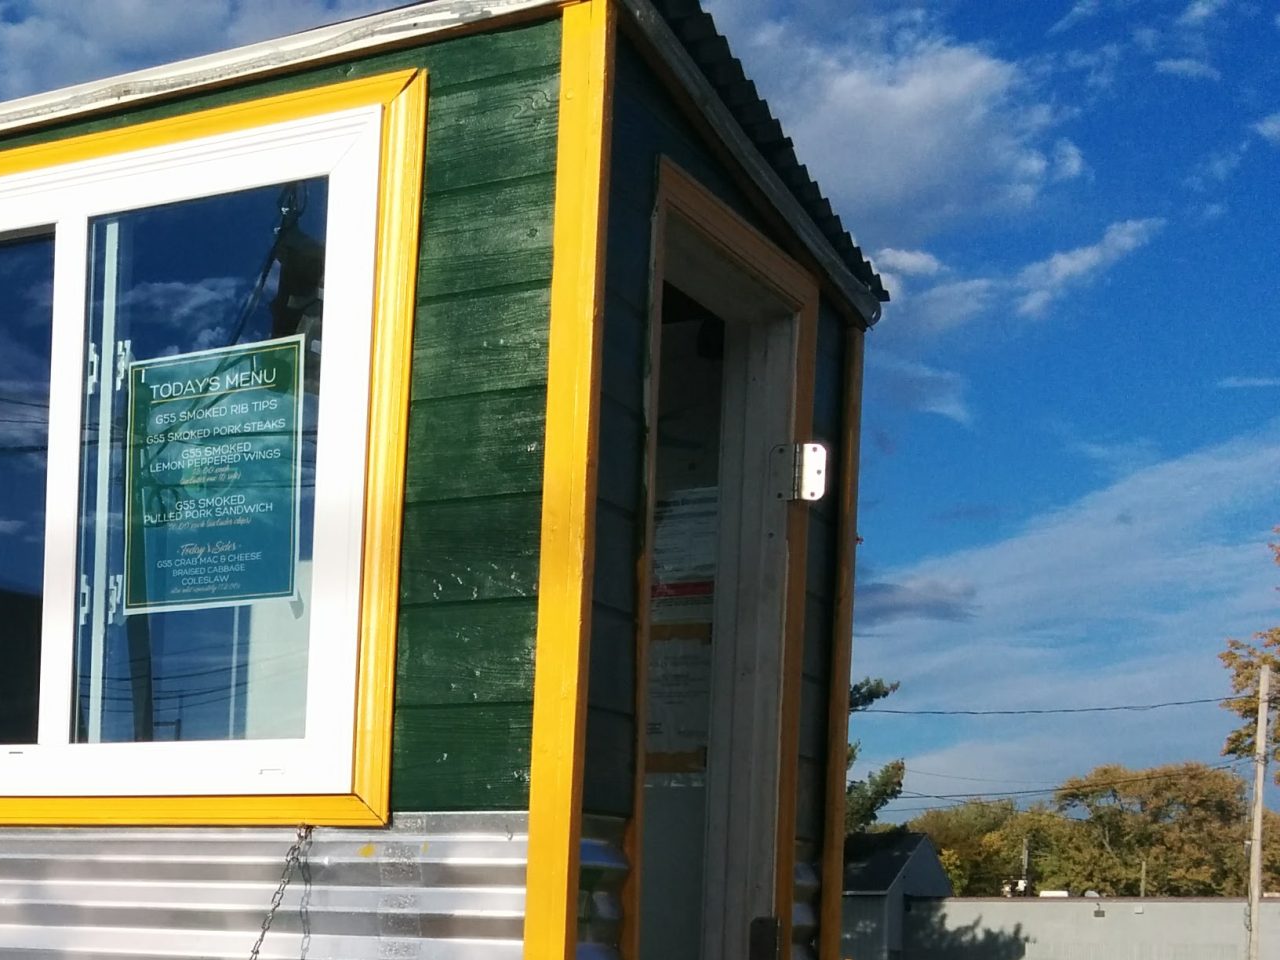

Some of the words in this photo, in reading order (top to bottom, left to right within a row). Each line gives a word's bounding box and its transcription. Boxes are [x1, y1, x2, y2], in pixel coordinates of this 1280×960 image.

[150, 375, 220, 399] TODAY'S
[225, 367, 276, 387] MENU
[155, 411, 177, 425] G55
[179, 407, 227, 422] SMOKED
[231, 403, 249, 415] RIB
[252, 400, 278, 412] TIPS
[146, 434, 165, 445] G55
[167, 429, 211, 442] SMOKED
[213, 424, 242, 437] PORK
[243, 418, 286, 432] STEAKS
[181, 447, 202, 459] G55
[204, 441, 252, 457] SMOKED
[149, 460, 185, 473] LEMON
[187, 453, 241, 469] PEPPERED
[243, 449, 281, 462] WINGS
[175, 499, 196, 511] G55
[198, 494, 246, 509] SMOKED
[144, 510, 183, 524] PULLED
[185, 508, 213, 519] PORK
[215, 502, 273, 517] SANDWICH
[156, 560, 173, 569] G55
[174, 557, 198, 567] CRAB
[199, 555, 218, 564] MAC
[227, 551, 262, 562] CHEESE
[172, 567, 206, 577] BRAISED
[207, 563, 246, 574] CABBAGE
[181, 574, 229, 586] COLESLAW
